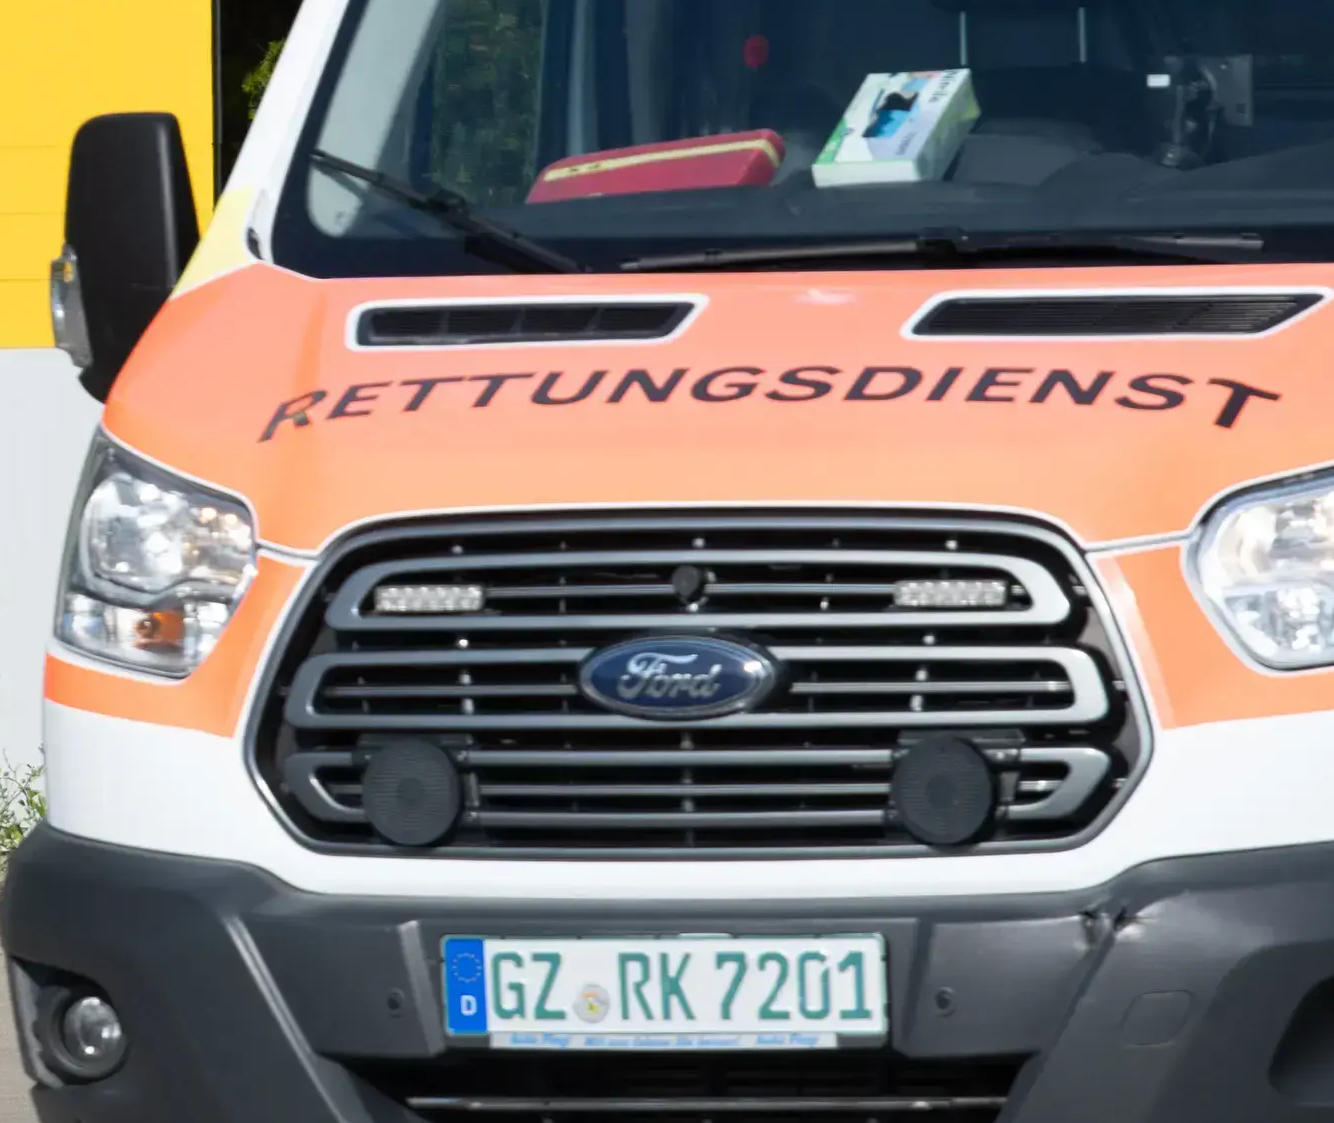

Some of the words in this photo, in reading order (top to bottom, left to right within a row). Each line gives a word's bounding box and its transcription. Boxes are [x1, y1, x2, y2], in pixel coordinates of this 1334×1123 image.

[258, 364, 1282, 443] RETTUNGSDIENST
[617, 651, 723, 699] Ford
[460, 994, 478, 1017] D
[491, 951, 568, 1021] GZ
[618, 951, 696, 1021] RK
[716, 951, 874, 1021] 7201
